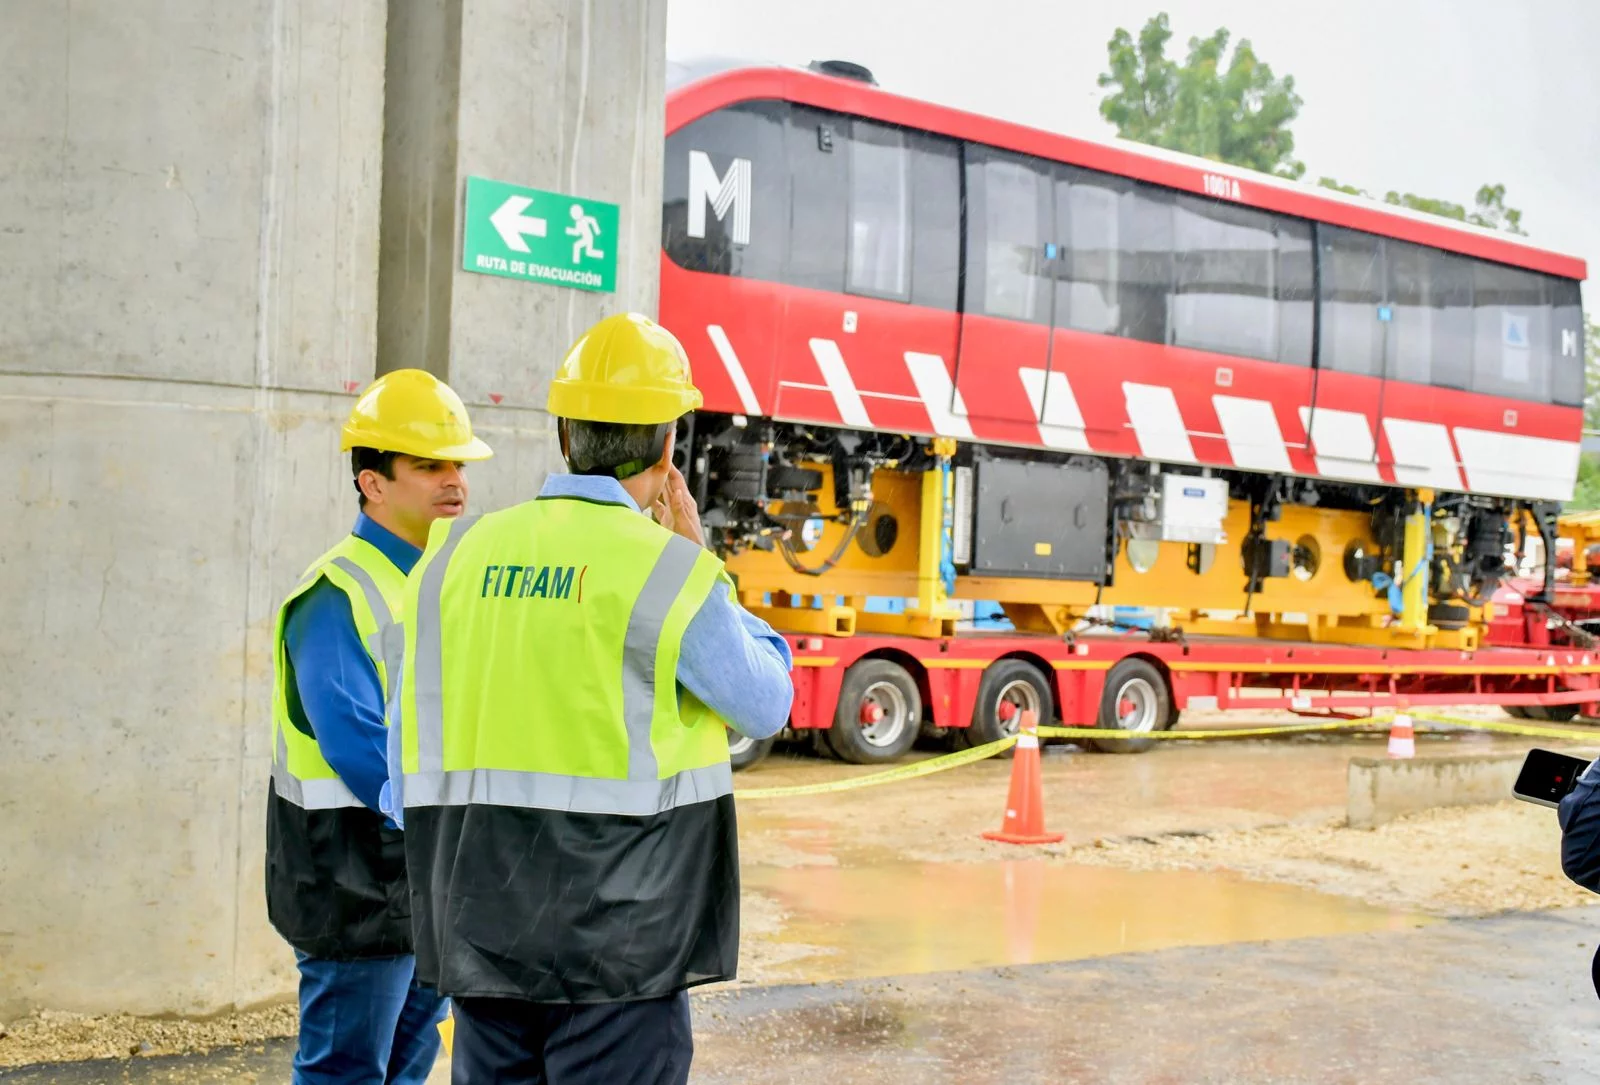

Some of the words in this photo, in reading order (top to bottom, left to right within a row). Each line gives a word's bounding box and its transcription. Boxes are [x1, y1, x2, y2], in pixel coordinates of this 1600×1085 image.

[687, 150, 752, 245] M
[1203, 173, 1241, 199] 1001A
[476, 254, 508, 271] RUTA
[510, 260, 526, 274] DE
[528, 263, 602, 287] EVACUACIÓN
[481, 565, 576, 599] FITRAM
